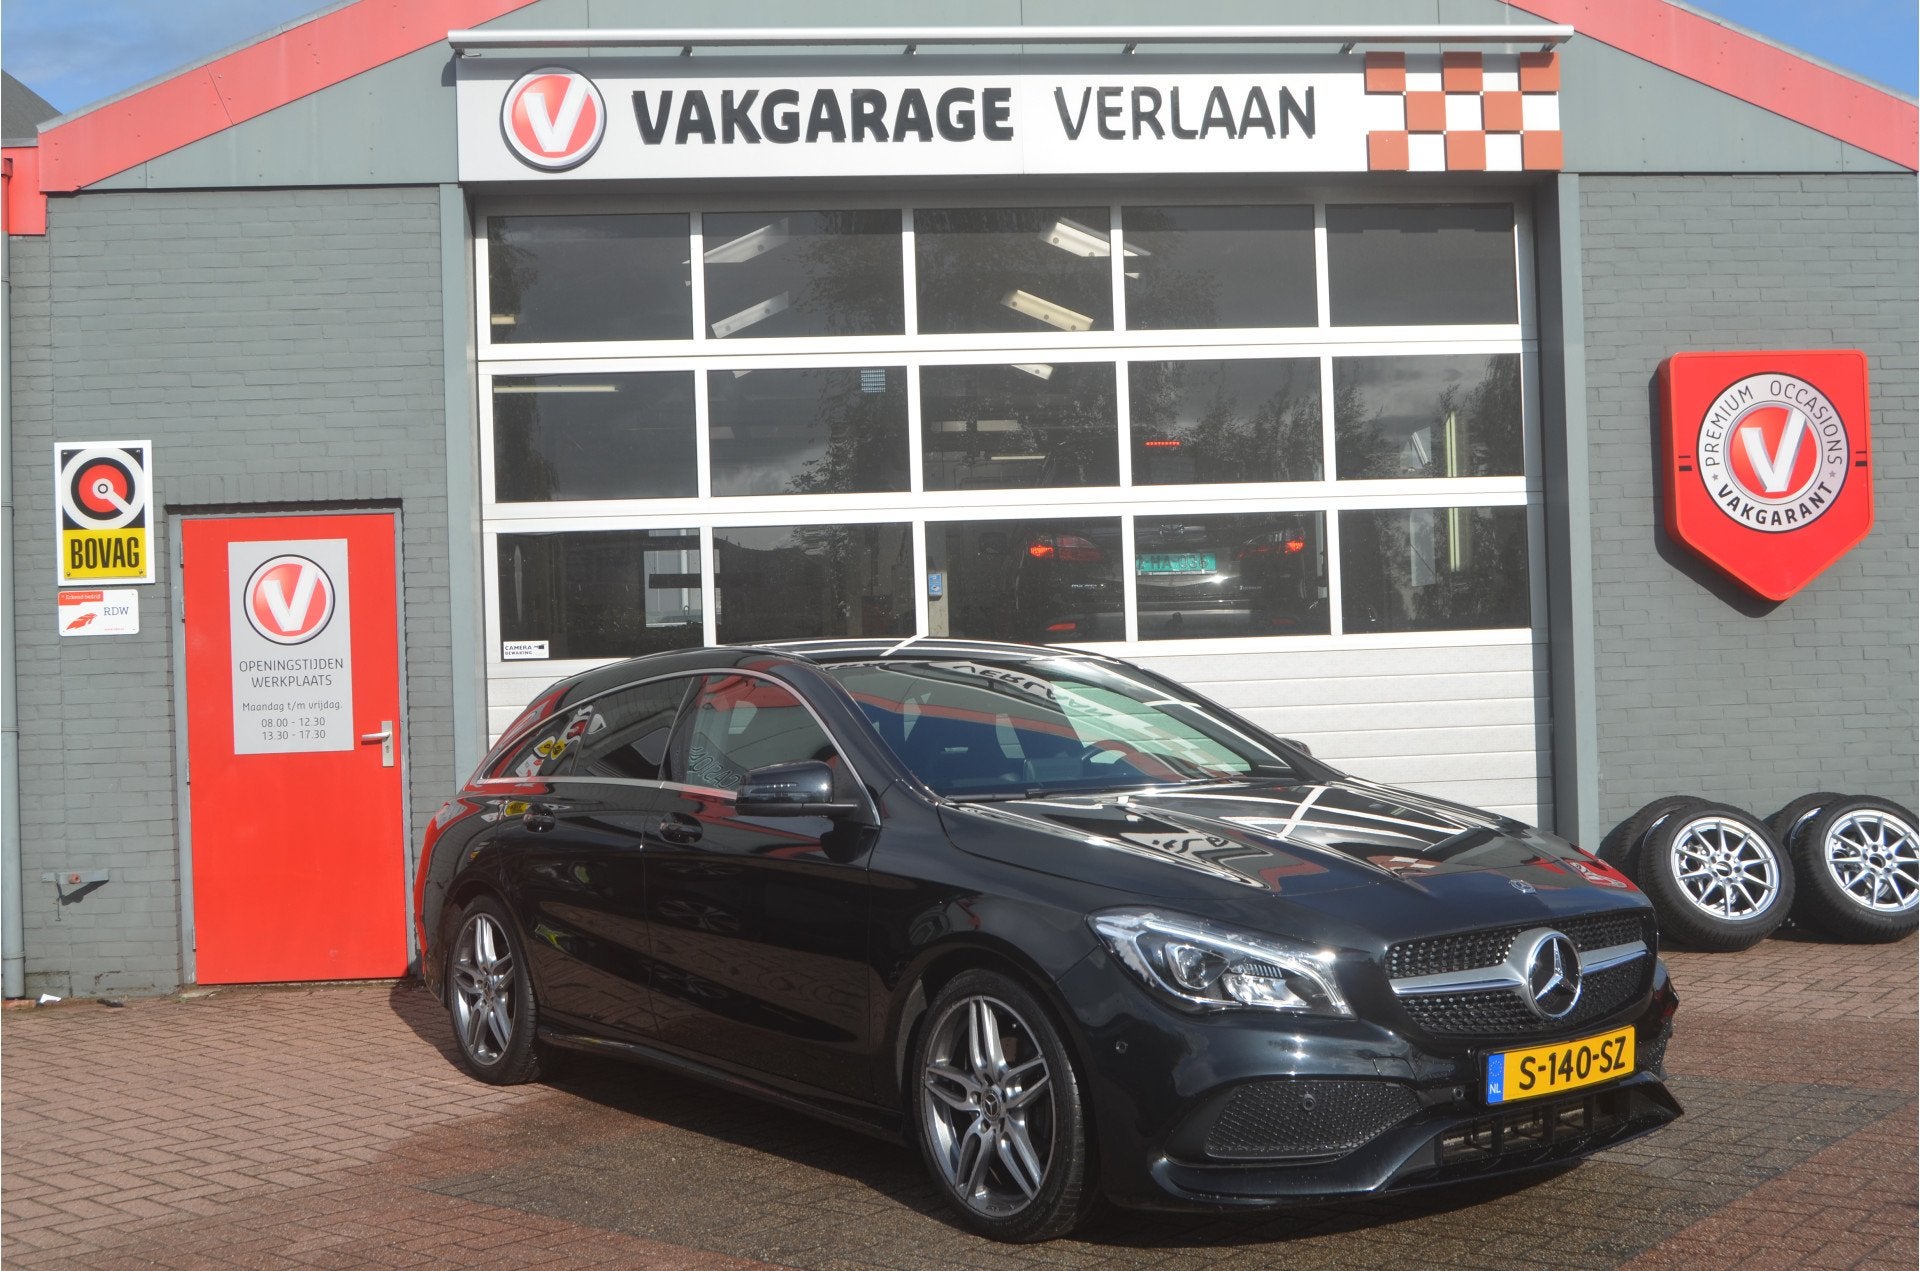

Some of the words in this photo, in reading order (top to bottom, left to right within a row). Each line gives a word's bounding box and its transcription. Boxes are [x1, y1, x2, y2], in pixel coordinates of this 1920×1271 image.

[631, 86, 1014, 145] VAKGARAGE
[1053, 85, 1317, 141] VERLAAN
[1704, 385, 1754, 467] PREMIUM
[1769, 379, 1843, 466] OCCASIONS
[1717, 480, 1833, 526] VAKGARANT
[69, 536, 140, 570] BOVAG
[103, 606, 129, 616] RDW
[239, 658, 344, 672] OPENINGSTIJDEN
[251, 674, 333, 688] WERKPLAATS
[242, 702, 284, 712] Maandag
[287, 701, 306, 711] t/m
[261, 718, 288, 728] 08.00
[299, 717, 326, 727] 12.30
[262, 730, 289, 740] 13.30
[299, 729, 326, 739] 17.30
[1518, 1035, 1627, 1091] S-140-SZ
[1489, 1082, 1502, 1094] NL
